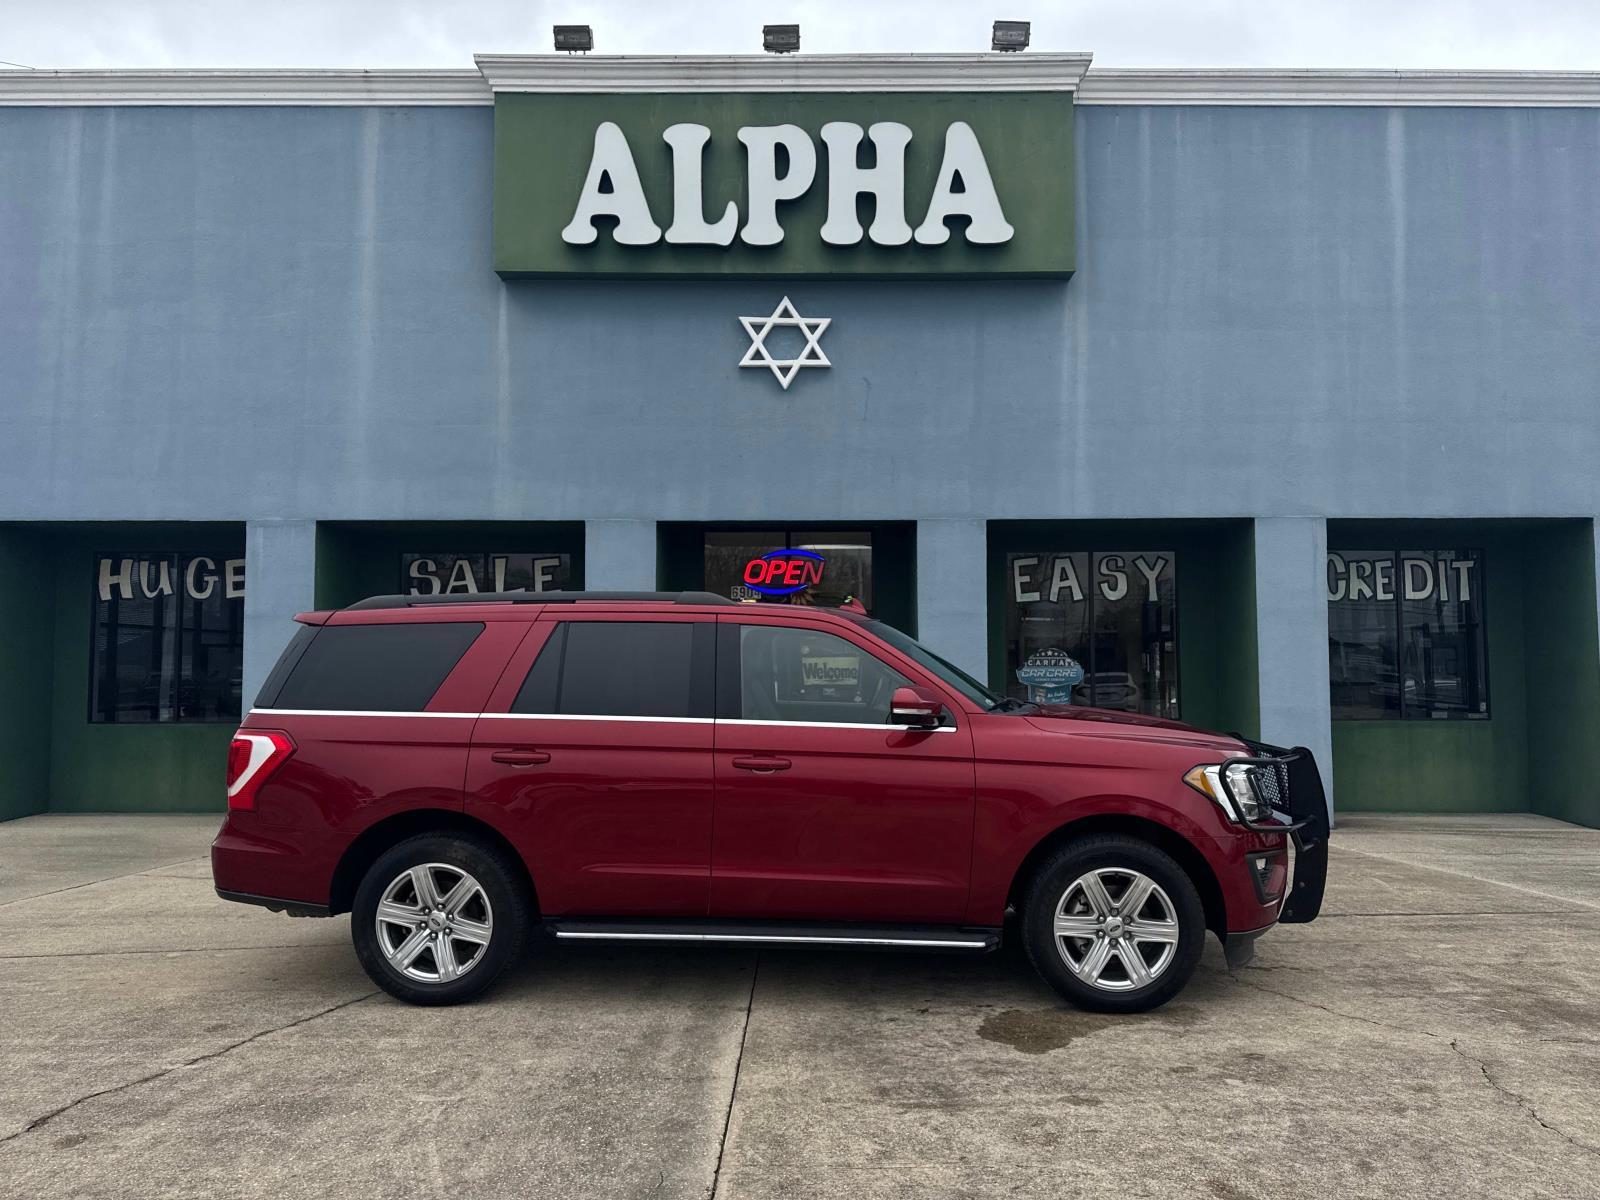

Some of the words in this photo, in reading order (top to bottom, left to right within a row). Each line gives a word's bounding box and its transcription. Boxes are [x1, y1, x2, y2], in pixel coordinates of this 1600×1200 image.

[561, 121, 1015, 247] ALPHA
[98, 556, 245, 601] HUGE
[409, 556, 562, 595] SALE
[1013, 554, 1168, 603] EASY
[1327, 553, 1475, 602] CREDIT
[743, 559, 825, 585] OPEN
[803, 662, 857, 680] Welcome
[1021, 669, 1045, 677] CAR
[1046, 669, 1077, 677] CARE
